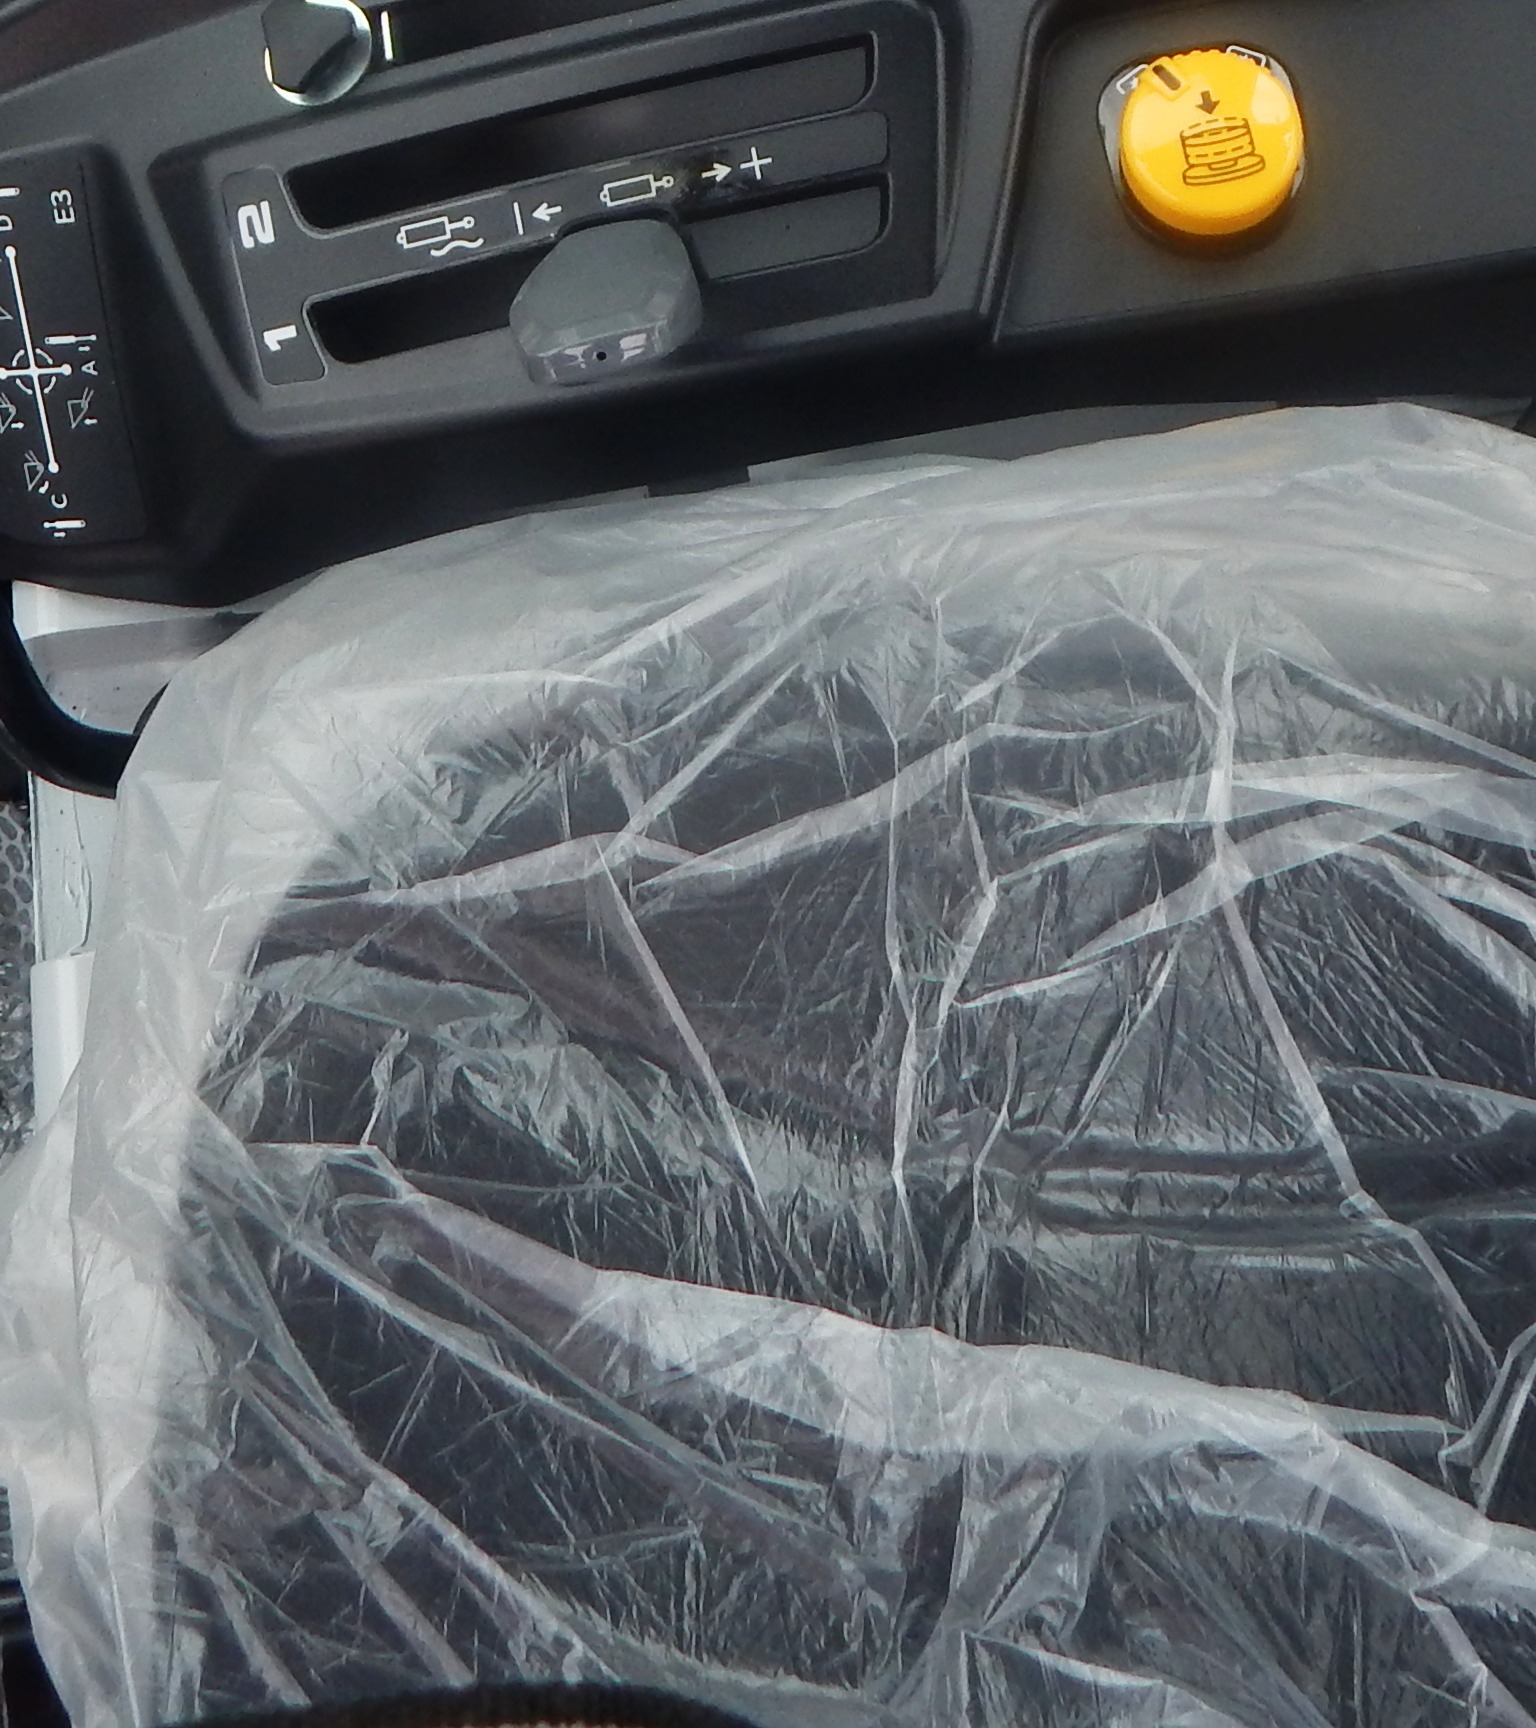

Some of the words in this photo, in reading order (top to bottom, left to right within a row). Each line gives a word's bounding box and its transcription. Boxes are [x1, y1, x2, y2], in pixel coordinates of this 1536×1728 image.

[50, 189, 76, 224] E3
[237, 200, 275, 249] 2
[263, 324, 297, 352] 1
[81, 360, 99, 376] A
[51, 493, 68, 509] C
